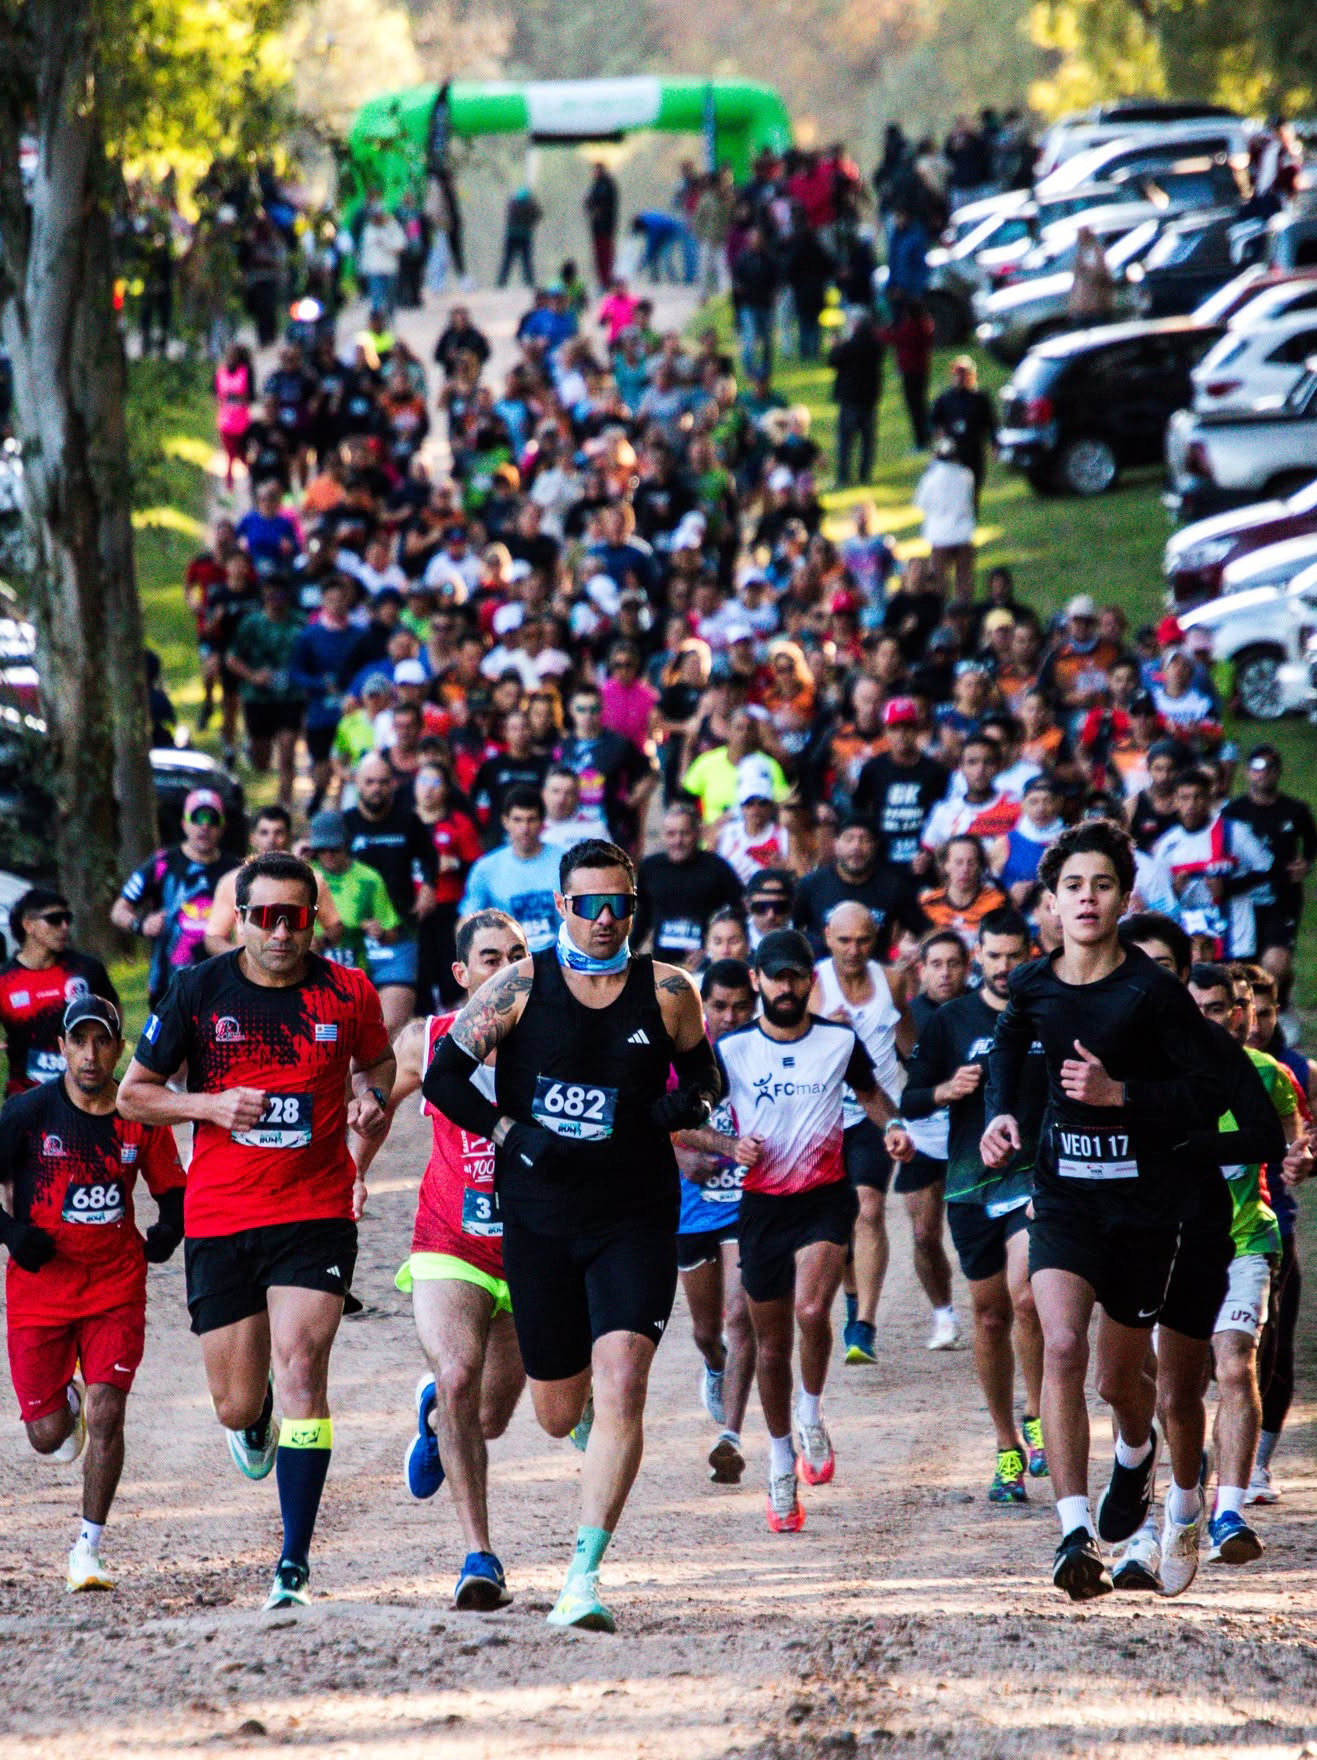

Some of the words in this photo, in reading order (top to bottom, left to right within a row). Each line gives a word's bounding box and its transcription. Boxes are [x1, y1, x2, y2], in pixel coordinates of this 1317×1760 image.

[774, 1082, 828, 1097] FCmax
[259, 1096, 300, 1124] 28
[544, 1083, 606, 1121] 682
[1108, 1135, 1129, 1157] 17
[472, 1158, 496, 1179] 100
[72, 1183, 121, 1209] 686
